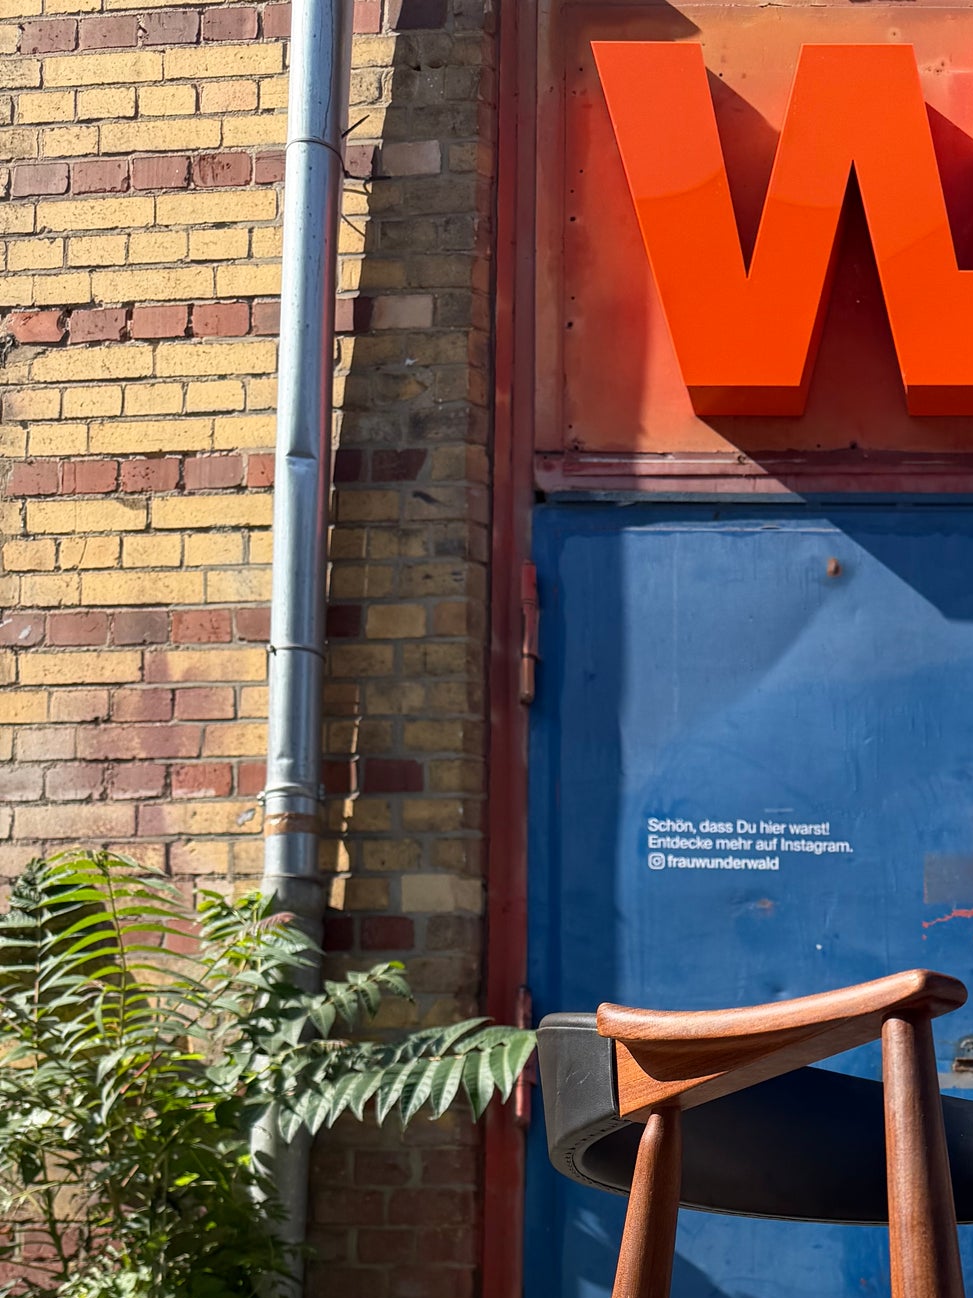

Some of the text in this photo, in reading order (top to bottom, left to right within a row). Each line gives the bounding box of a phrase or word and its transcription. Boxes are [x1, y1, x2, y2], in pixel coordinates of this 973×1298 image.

[647, 817, 830, 836] Schön, dass Du hier warst!
[647, 835, 854, 855] Entdecke mehr auf Instagram.
[667, 854, 780, 871] frauwunderwald
